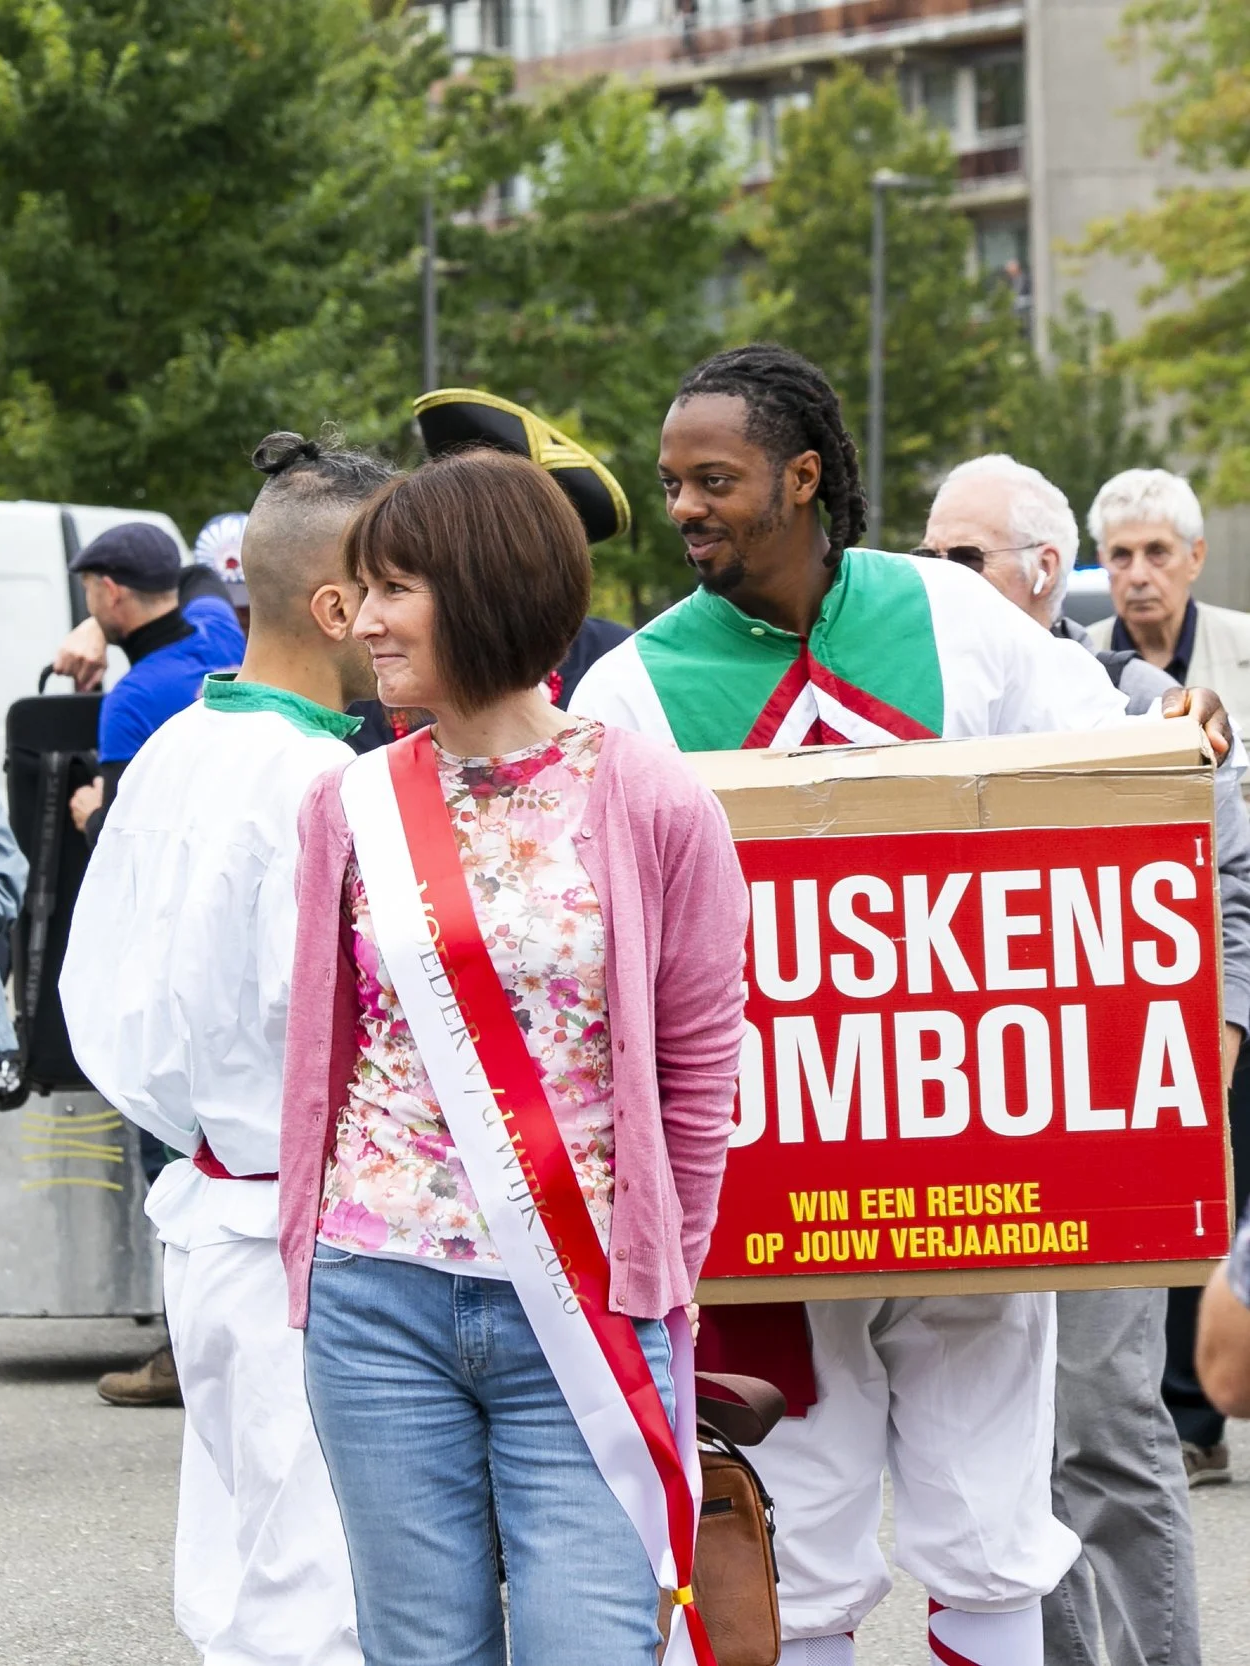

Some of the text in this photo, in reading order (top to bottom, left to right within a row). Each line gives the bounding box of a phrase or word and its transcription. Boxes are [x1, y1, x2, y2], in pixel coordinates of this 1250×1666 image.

[744, 861, 1201, 1001] USKENS
[728, 1000, 1208, 1148] MBOLA
[746, 1220, 1089, 1264] OP JOUW VERJAARDAG!
[789, 1182, 1041, 1222] WIN EEN REUSKE
